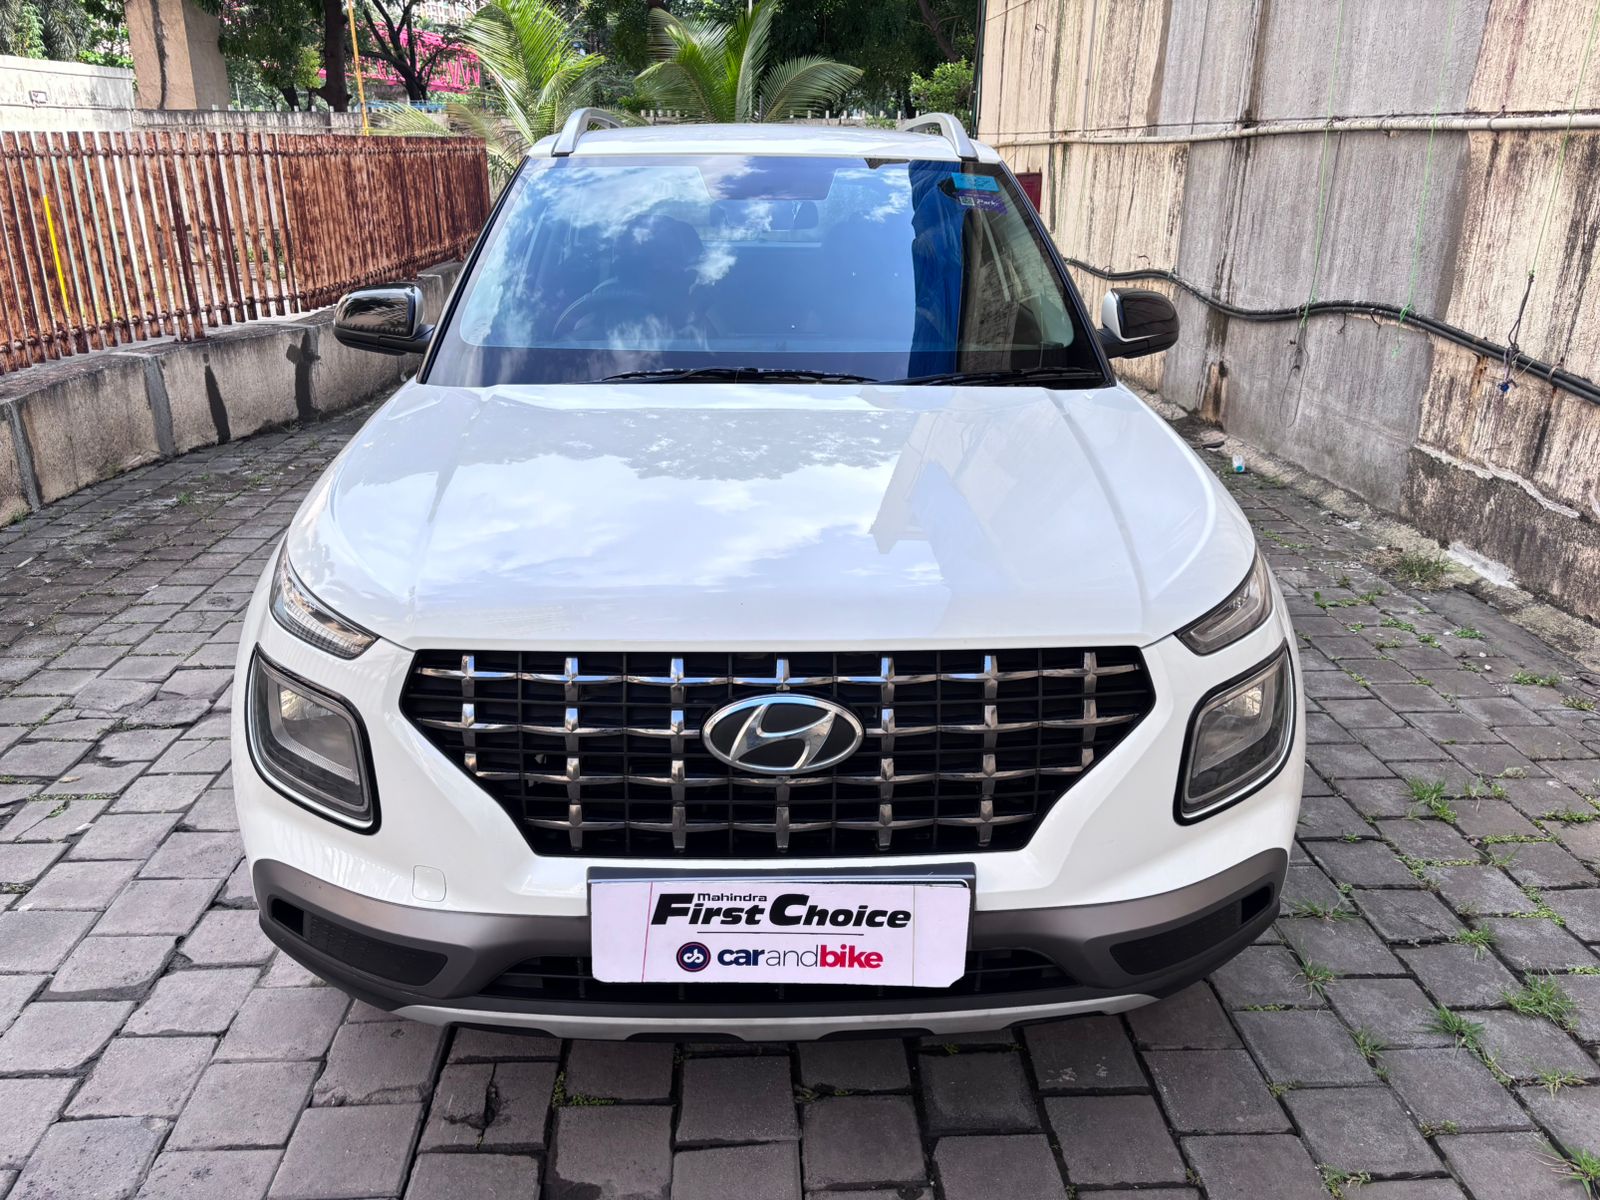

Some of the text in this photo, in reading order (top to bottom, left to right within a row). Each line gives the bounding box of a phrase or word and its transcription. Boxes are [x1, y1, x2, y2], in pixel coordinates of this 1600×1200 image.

[697, 893, 767, 902] Mahindra
[651, 893, 912, 928] First Choice
